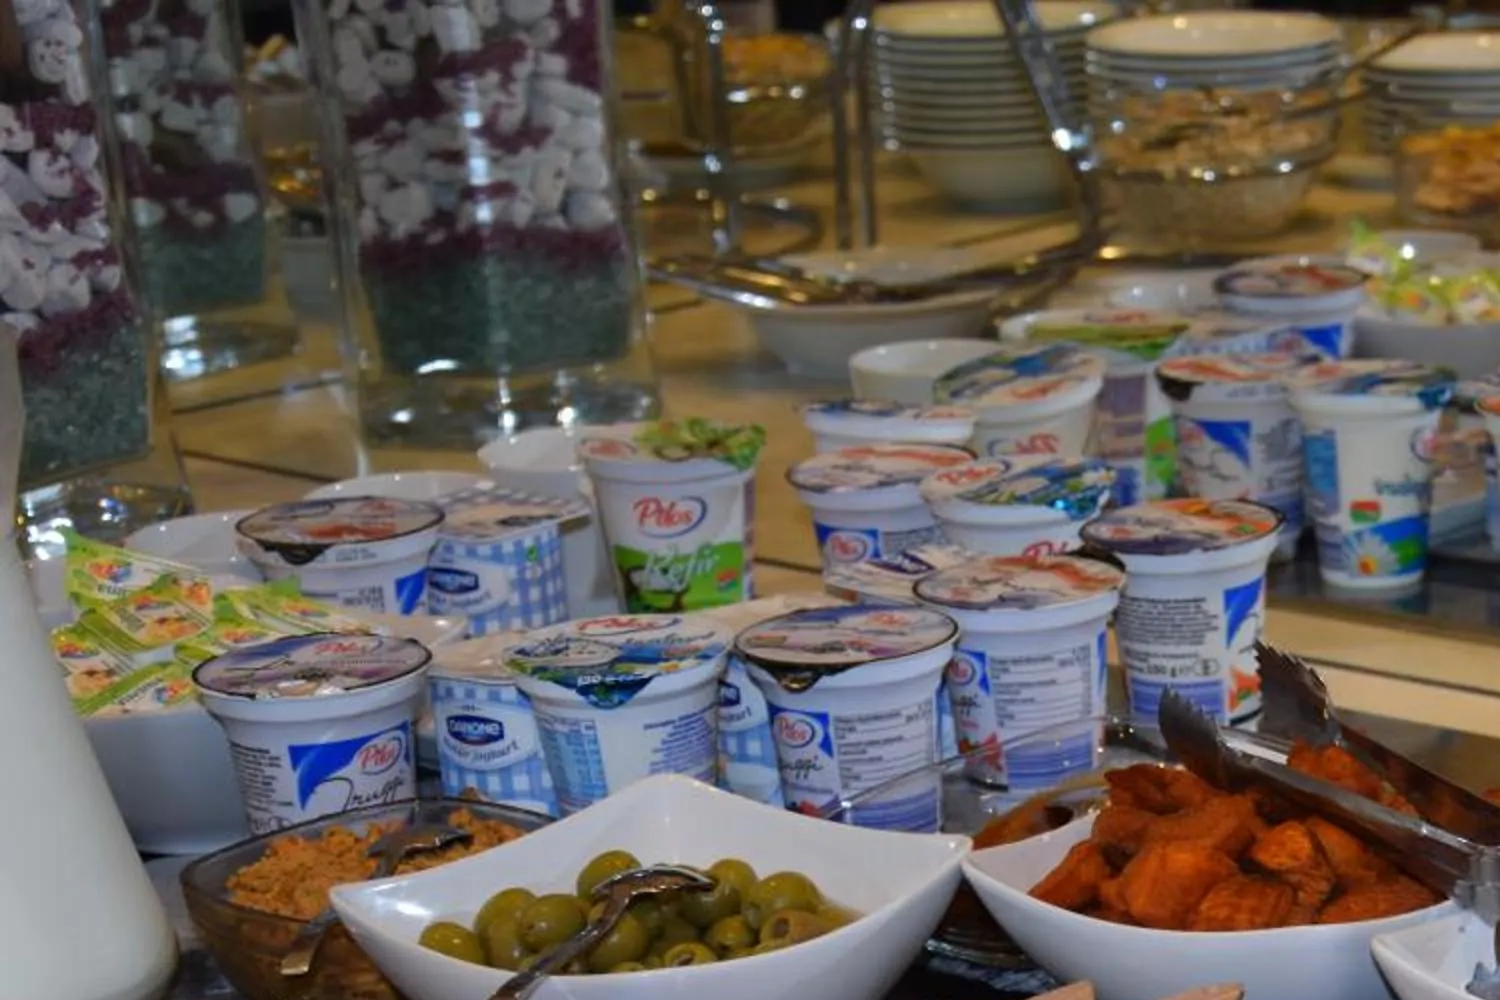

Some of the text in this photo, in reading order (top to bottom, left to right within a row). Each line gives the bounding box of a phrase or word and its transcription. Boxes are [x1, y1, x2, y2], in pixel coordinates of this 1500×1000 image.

[633, 496, 696, 530] Pilos
[776, 716, 811, 744] Pilos
[357, 738, 399, 775] Pilos
